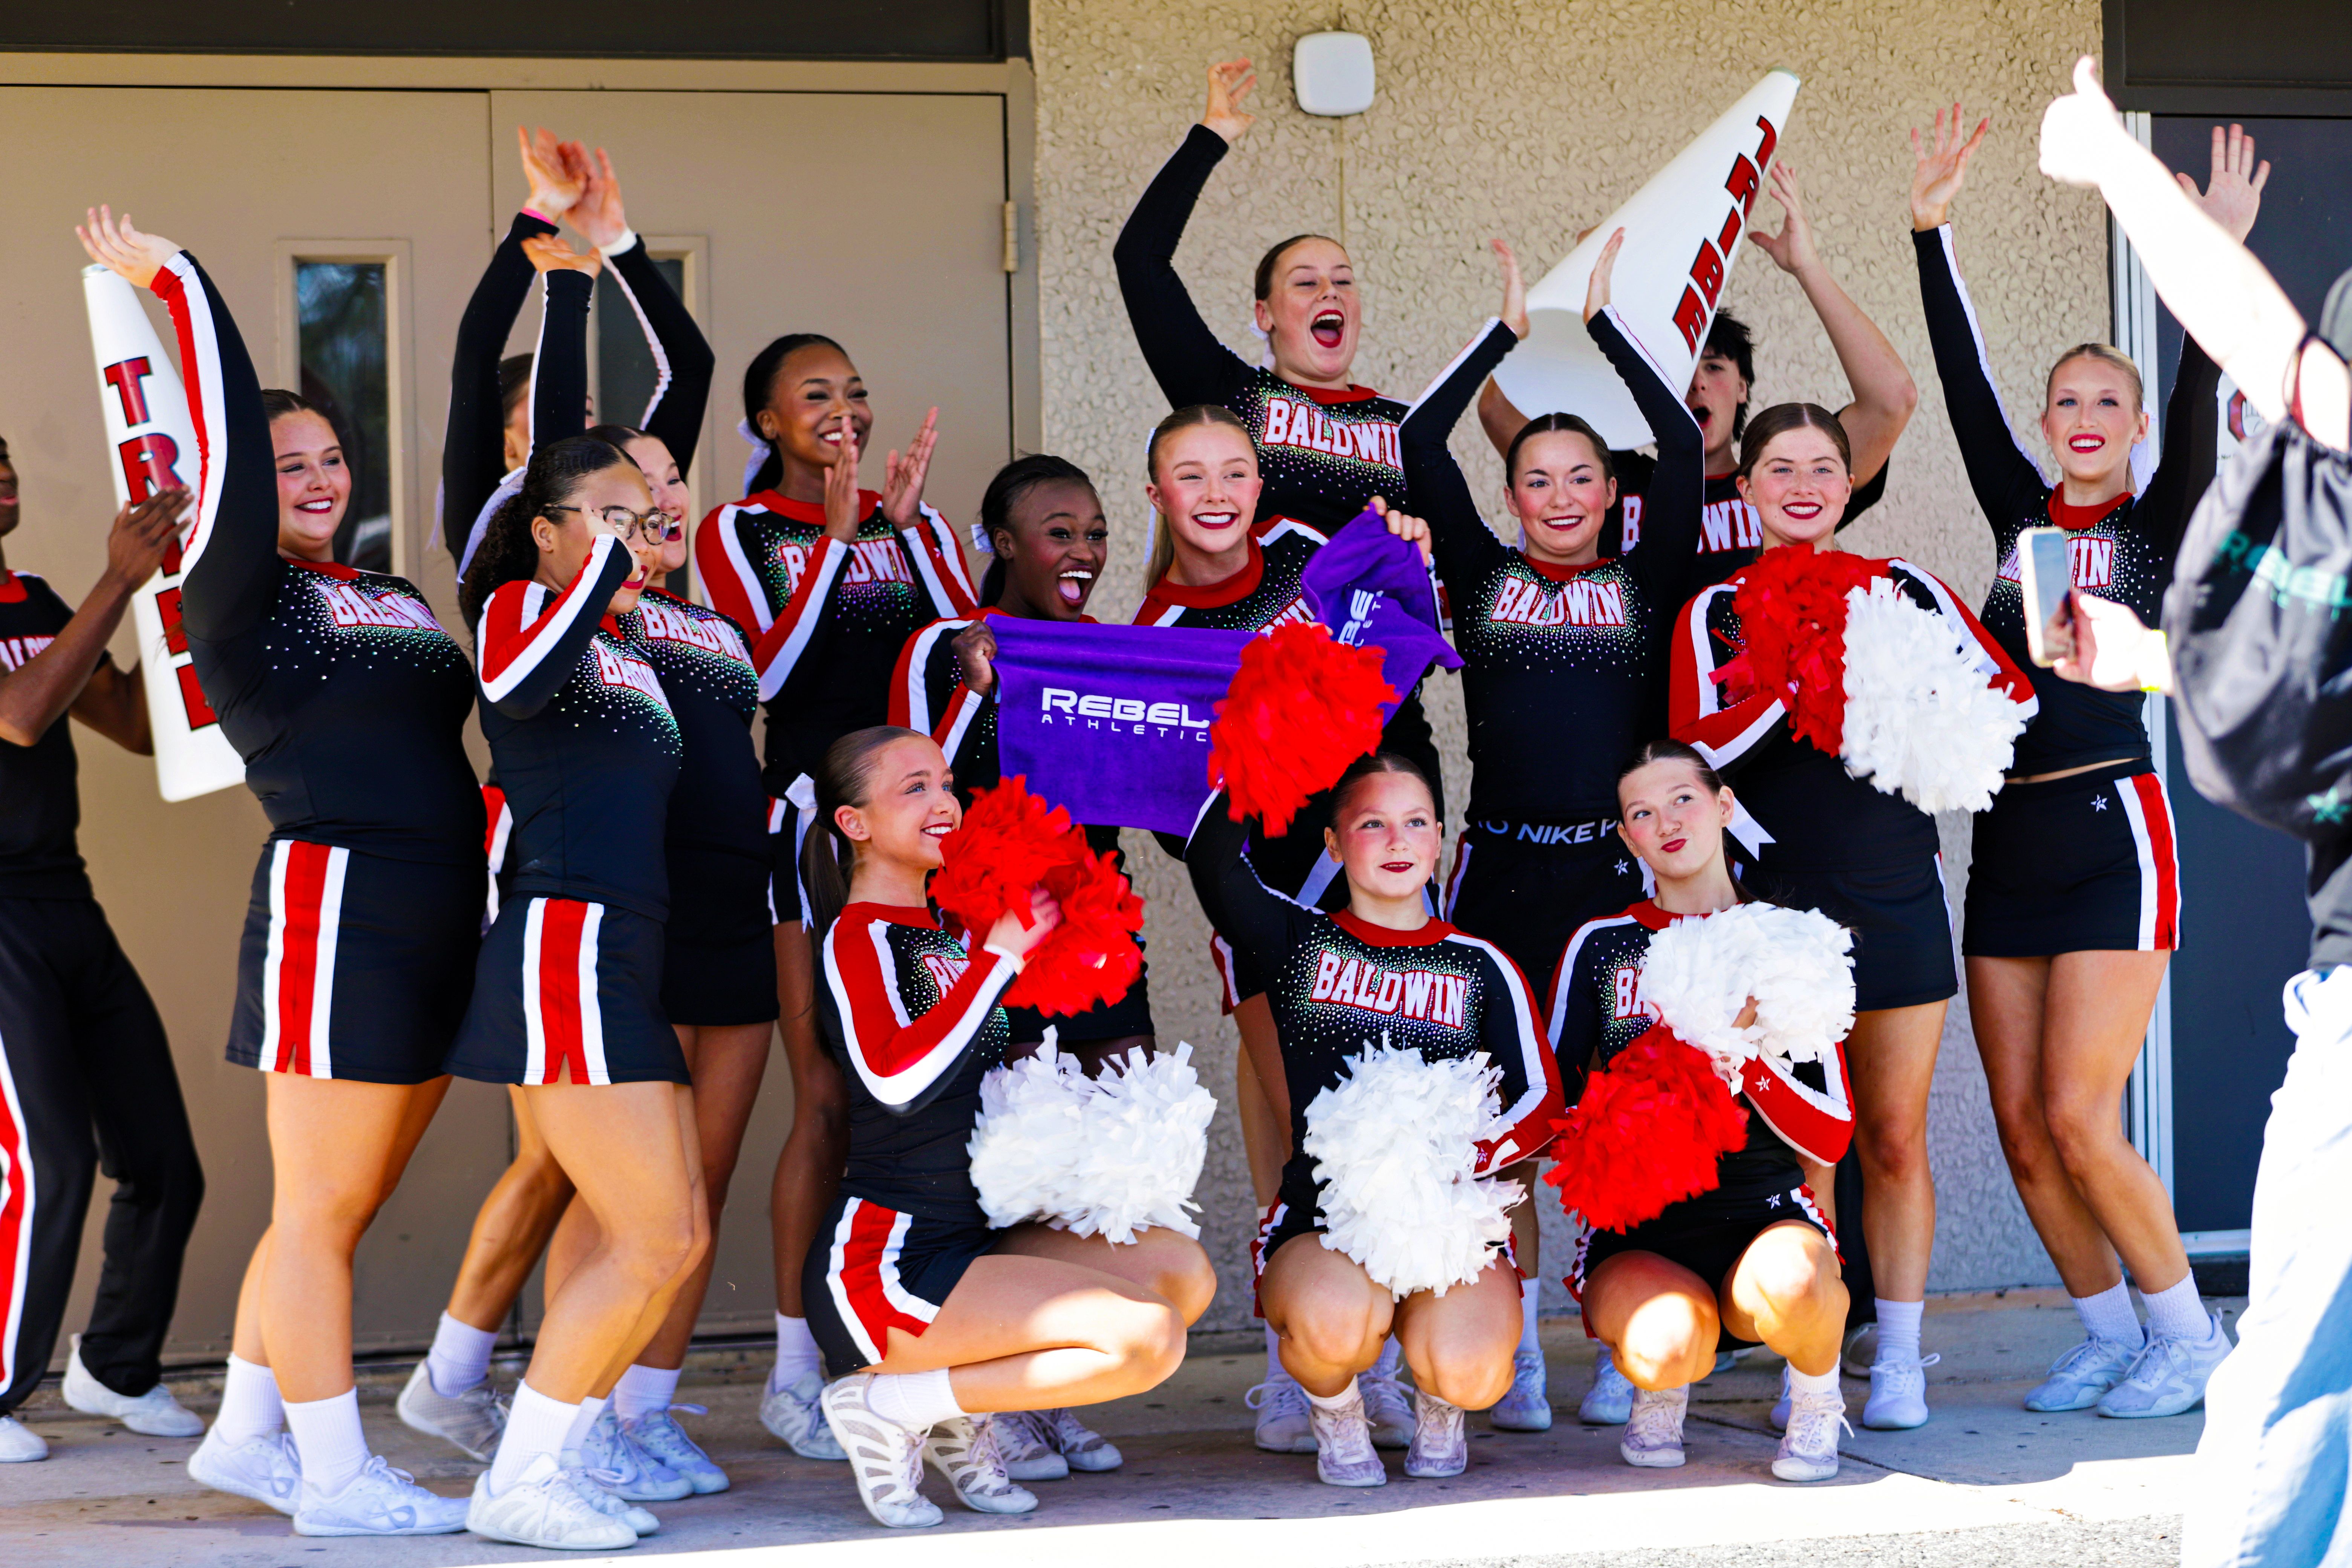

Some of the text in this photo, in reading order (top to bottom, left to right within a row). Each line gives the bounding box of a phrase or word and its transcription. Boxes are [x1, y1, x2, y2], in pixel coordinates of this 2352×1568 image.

[1621, 493, 1763, 555] BWIN
[1490, 576, 1626, 626] BALDWIN
[1041, 714, 1207, 742] ATHLETIC
[1042, 688, 1210, 728] REBEL
[1517, 821, 1595, 844] NIKE
[1310, 950, 1467, 1030] BALDWIN
